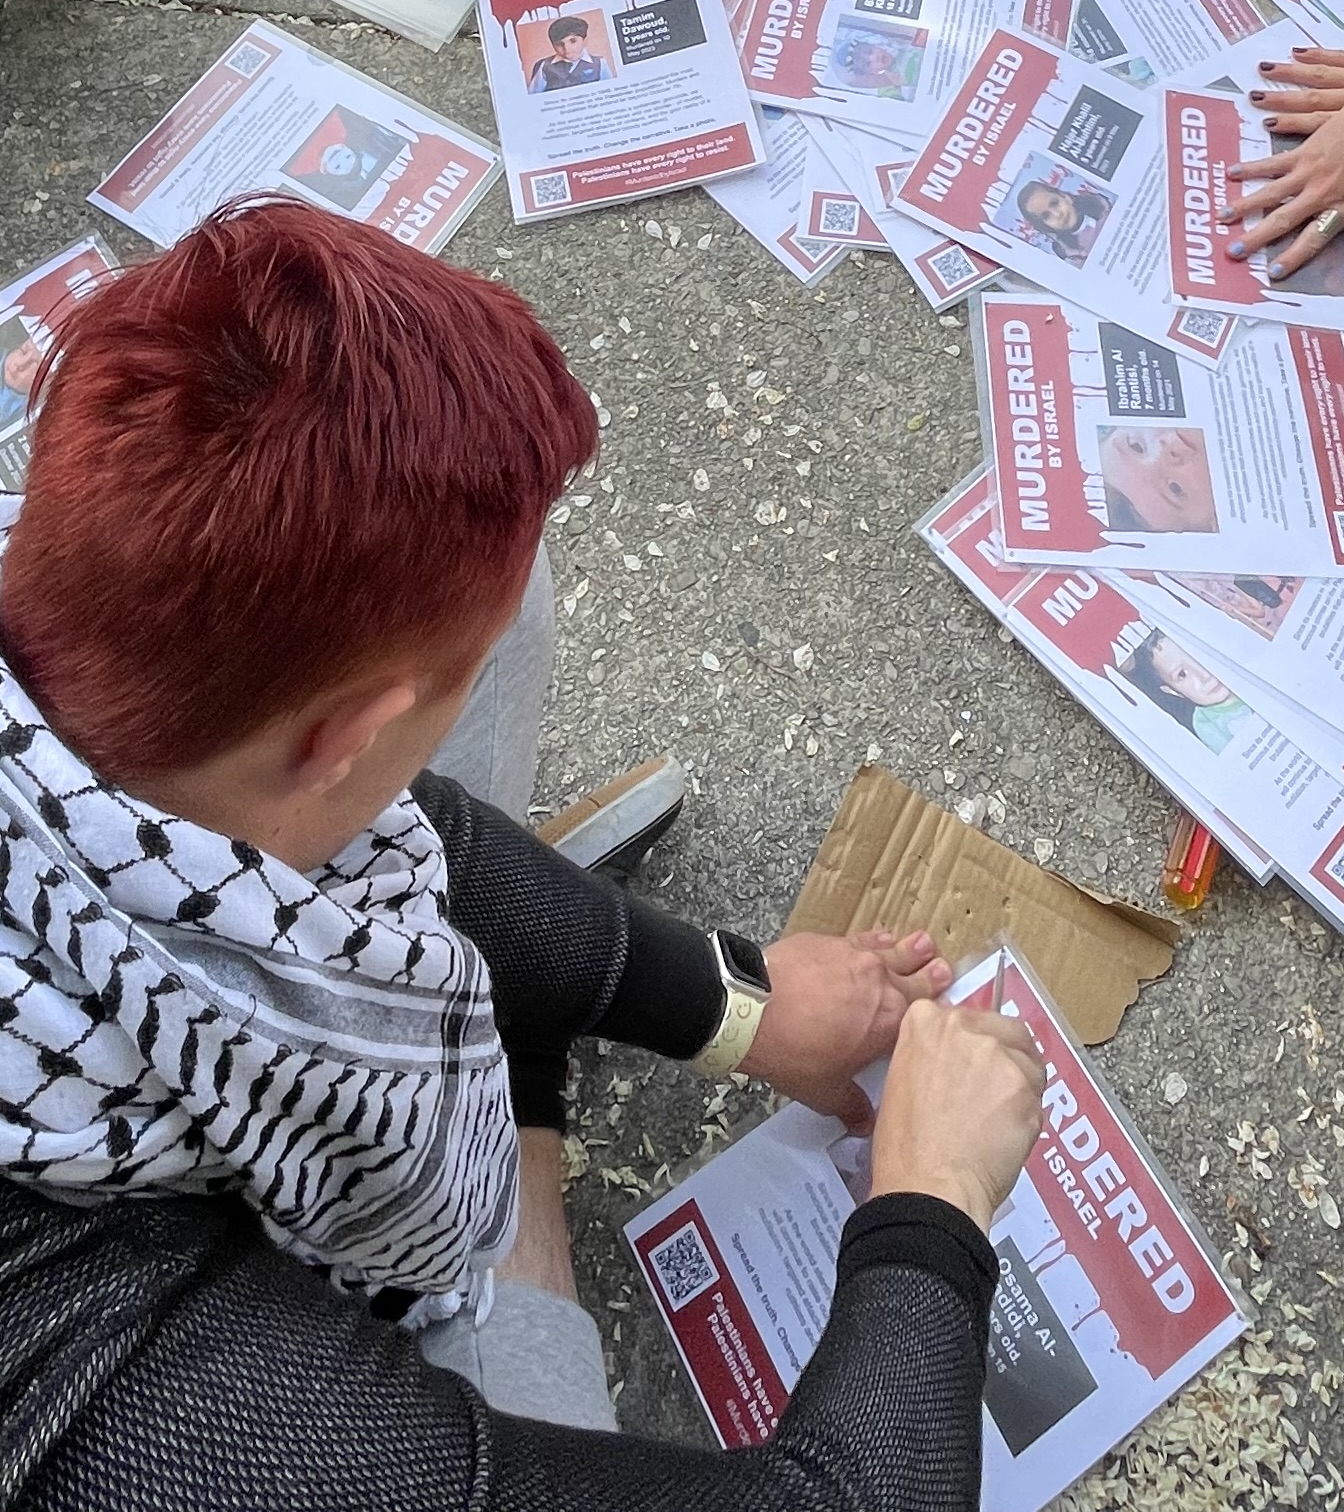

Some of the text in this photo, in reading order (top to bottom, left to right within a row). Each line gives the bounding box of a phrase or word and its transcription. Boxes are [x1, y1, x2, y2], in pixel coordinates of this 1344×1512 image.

[620, 12, 655, 27] Tamim
[622, 16, 668, 35] Dawoud,
[791, 21, 804, 39] BY
[631, 31, 653, 43] years
[919, 48, 1023, 202] MURDERED
[1071, 102, 1092, 129] Khalil
[972, 103, 1016, 166] BY ISRAEL
[572, 164, 621, 178] Palestinians
[622, 160, 642, 168] have
[643, 154, 665, 164] every
[666, 148, 685, 158] right
[581, 170, 630, 184] Palestinians
[631, 165, 651, 173] have
[652, 160, 673, 169] every
[675, 154, 695, 163] right
[391, 161, 469, 245] MURD
[393, 197, 411, 216] BY
[1181, 107, 1215, 285] MURDERED
[1137, 349, 1148, 365] old.
[1318, 362, 1325, 371] to
[1111, 349, 1129, 409] Ibrahim Al
[1125, 364, 1142, 409] Rantisi,
[1141, 367, 1153, 402] months
[1310, 370, 1317, 378] to
[1319, 372, 1331, 391] right
[1311, 380, 1323, 399] right
[1317, 401, 1328, 425] every
[1325, 393, 1336, 417] every
[1003, 320, 1050, 531] MURDERED
[1041, 380, 1062, 468] BY ISRAEL
[1322, 427, 1333, 448] have
[1330, 419, 1341, 441] have
[1000, 999, 1195, 1314] RDERED
[1043, 1144, 1100, 1241] ISRAEL
[731, 1233, 755, 1274] Spread
[751, 1273, 763, 1293] the
[761, 1294, 777, 1326] truth.
[995, 1283, 1025, 1338] adidi,
[999, 1258, 1056, 1356] Osama Al-
[712, 1292, 773, 1415] Palestinians have
[995, 1358, 1007, 1373] 15
[1001, 1336, 1021, 1366] old.
[707, 1312, 768, 1437] Palestinians have
